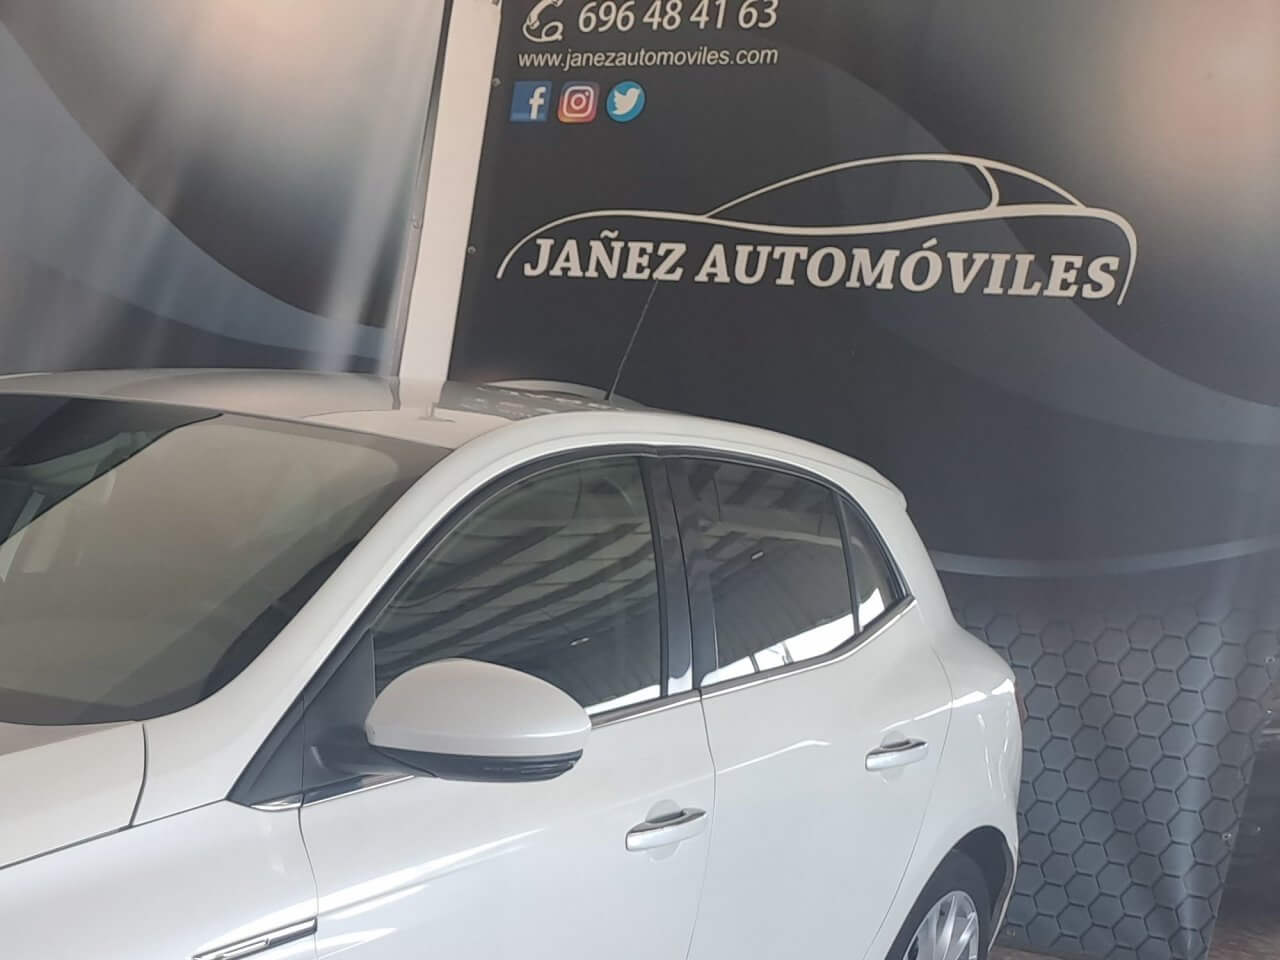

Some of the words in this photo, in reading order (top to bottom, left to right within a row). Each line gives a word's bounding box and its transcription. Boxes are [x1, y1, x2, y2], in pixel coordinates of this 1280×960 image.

[578, 0, 636, 33] 696
[642, 0, 683, 31] 48
[689, 0, 728, 30] 41
[737, 0, 780, 29] 63
[518, 46, 779, 71] www.janezautomoviles.com
[523, 229, 686, 281] JAÑEZ
[694, 237, 1120, 300] AUTOMÓVILES
